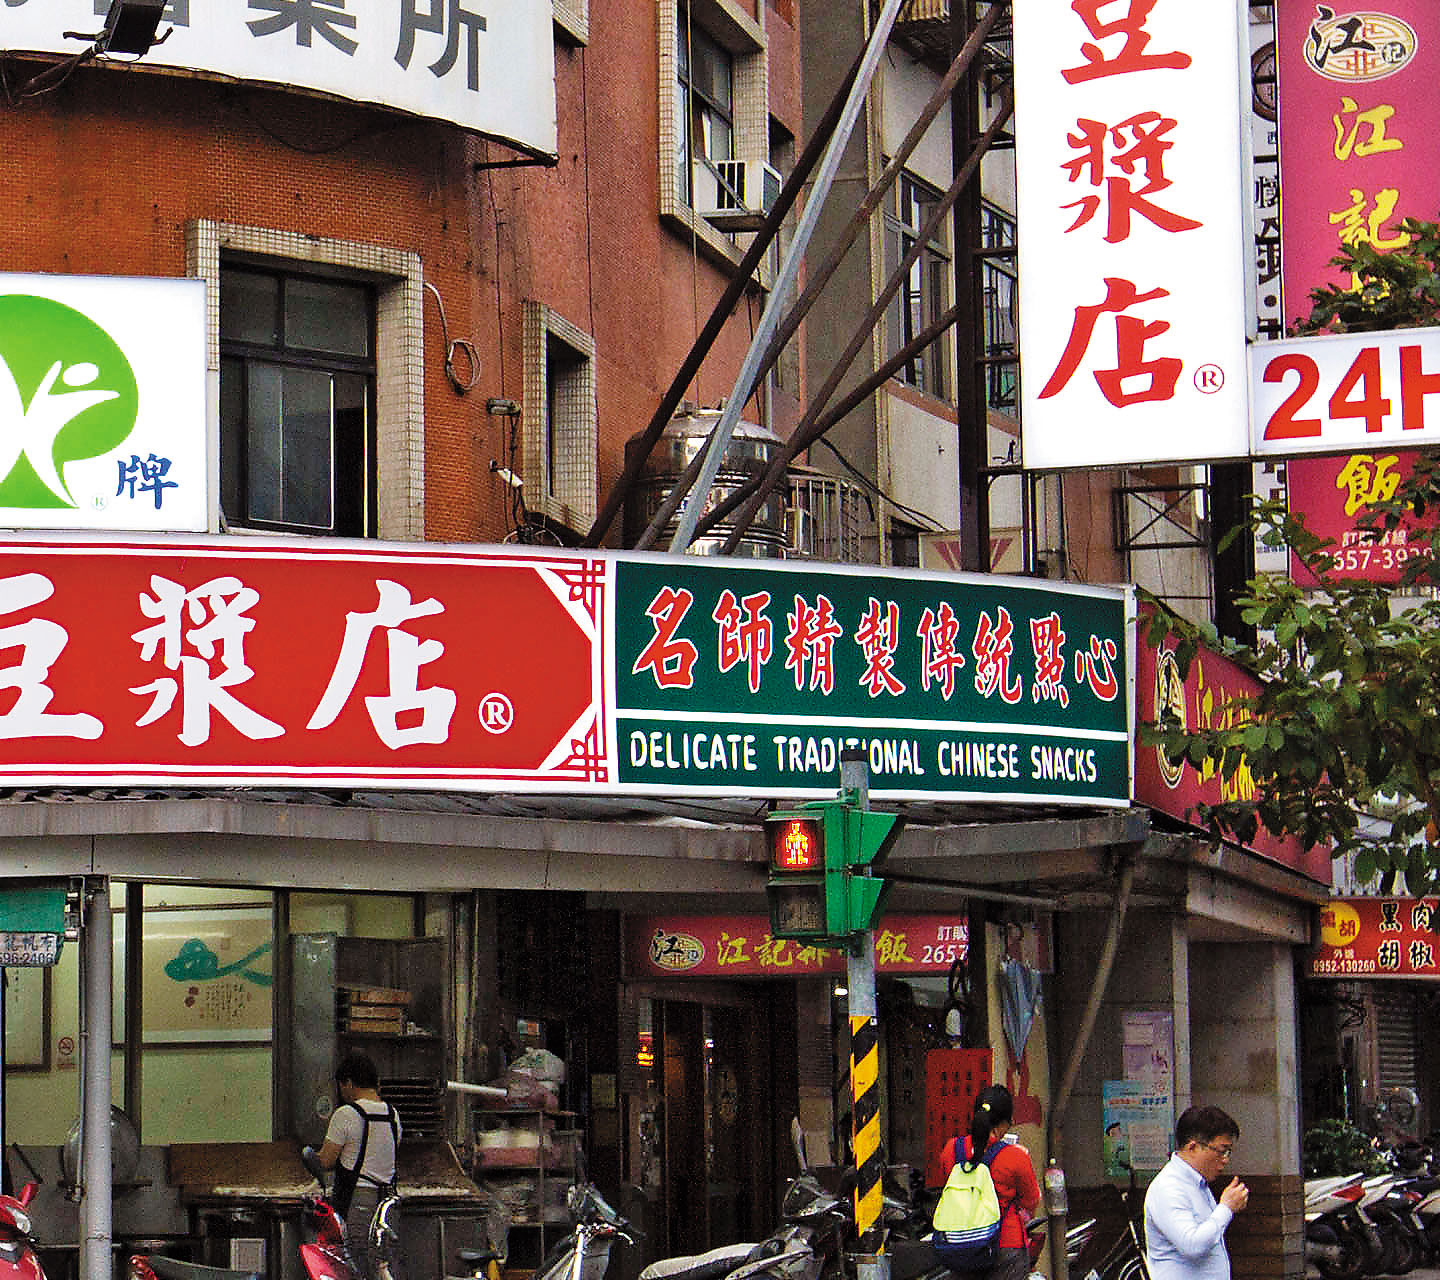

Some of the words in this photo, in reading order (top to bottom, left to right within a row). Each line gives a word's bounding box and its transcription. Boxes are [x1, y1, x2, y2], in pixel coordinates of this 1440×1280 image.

[116, 453, 180, 509] 牌
[631, 586, 1120, 709] 名師精製傳統點心
[629, 730, 757, 771] DELICATE
[937, 743, 1019, 780] CHINESE
[1030, 747, 1098, 784] SNACKS
